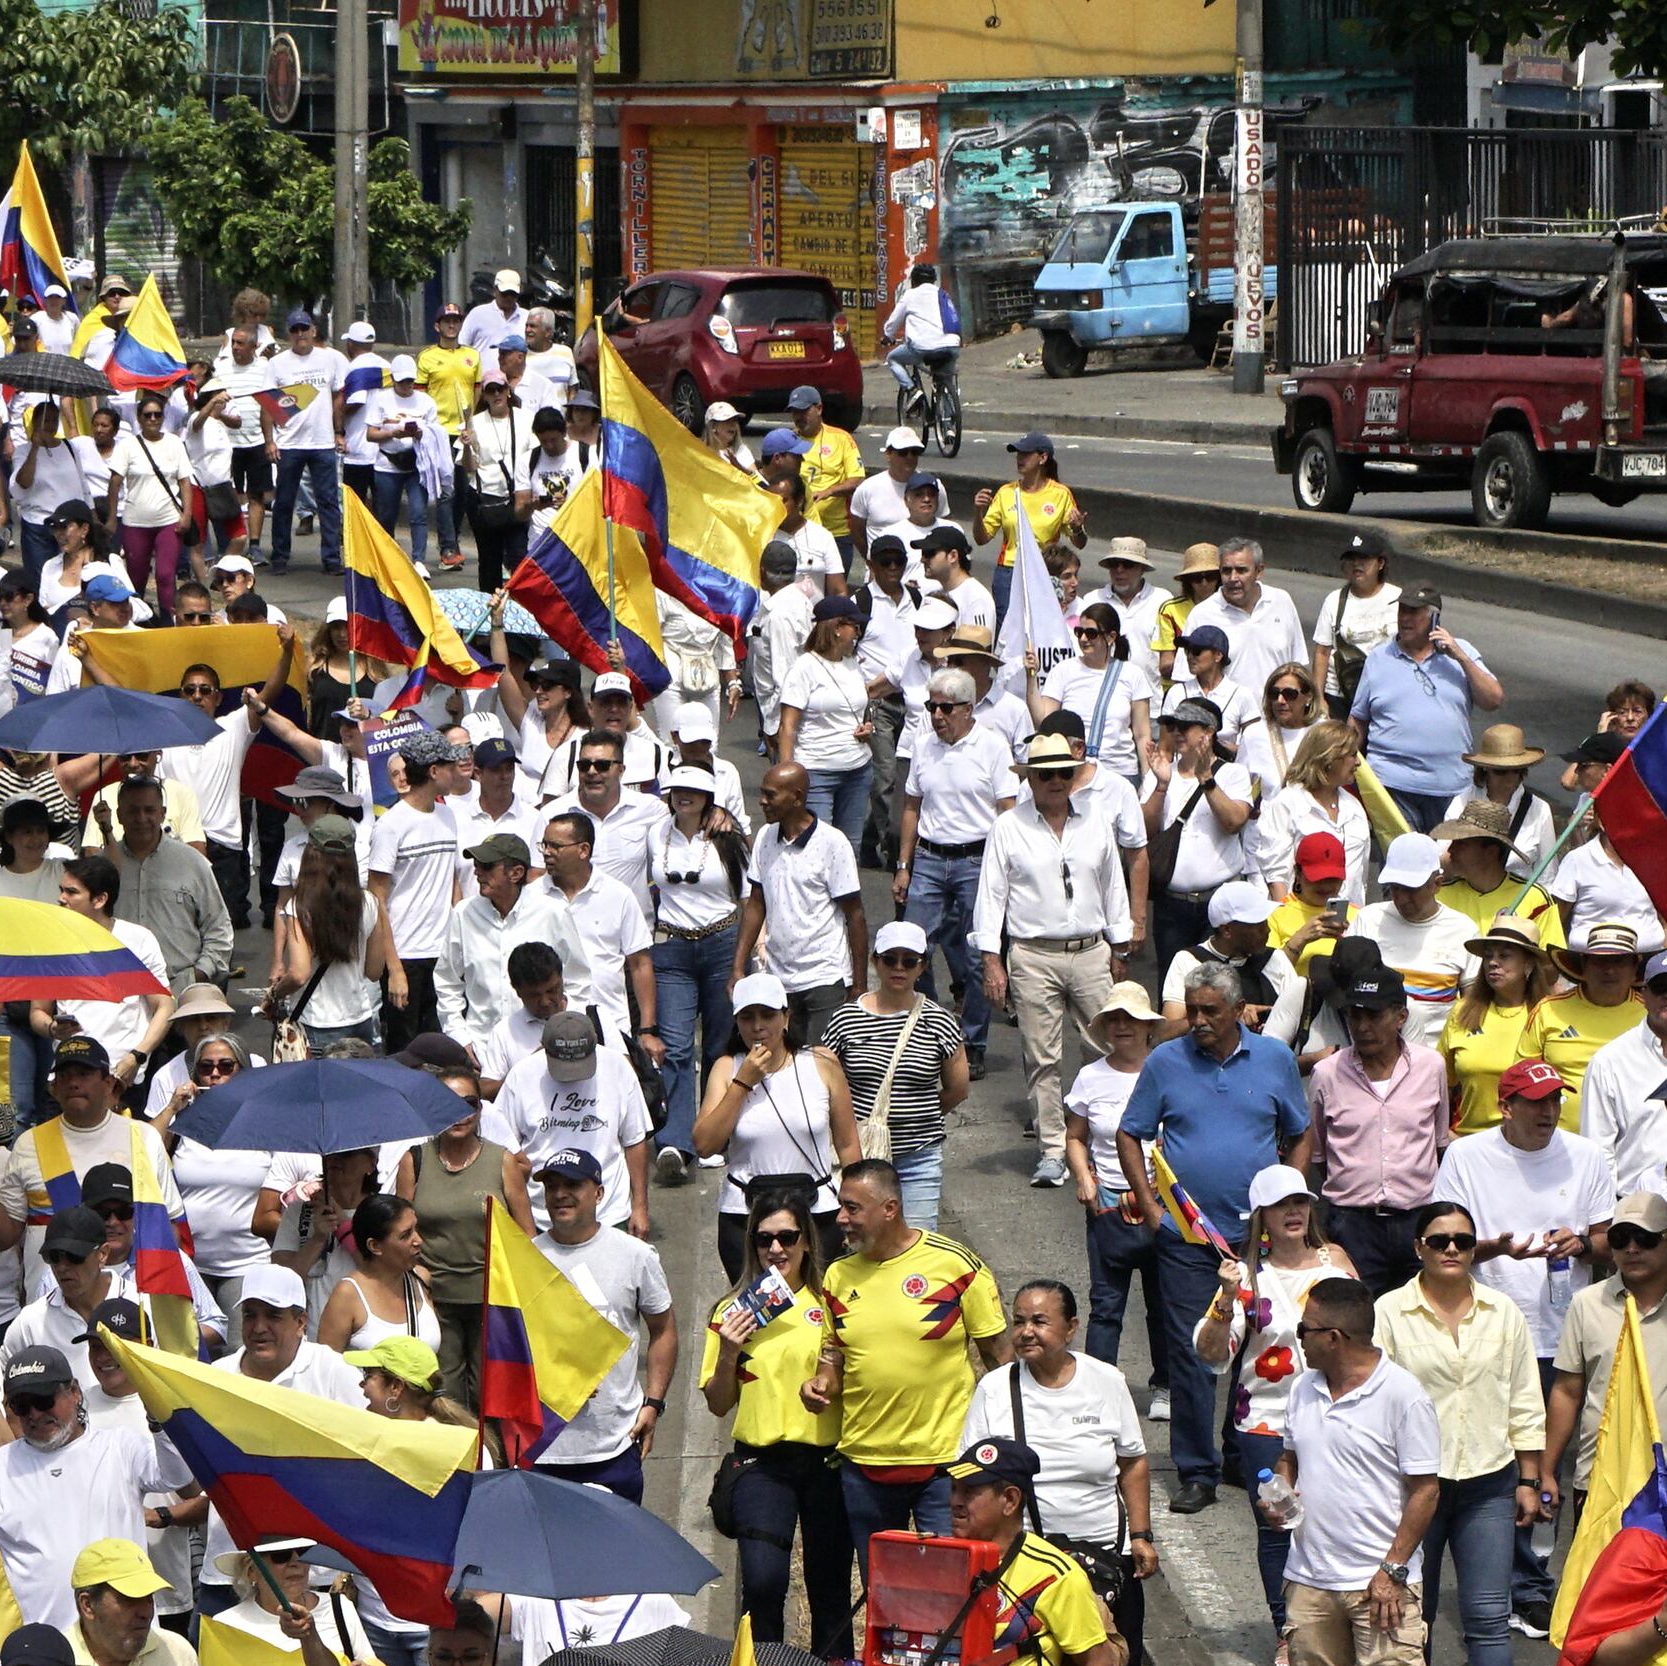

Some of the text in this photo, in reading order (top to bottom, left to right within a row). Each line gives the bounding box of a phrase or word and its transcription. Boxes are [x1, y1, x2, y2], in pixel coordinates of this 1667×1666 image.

[1246, 251, 1262, 339] UEVOS
[374, 721, 423, 742] COLOMBIA
[368, 738, 389, 755] ESTA
[550, 1092, 599, 1112] I Love
[9, 1361, 46, 1379] Colombia
